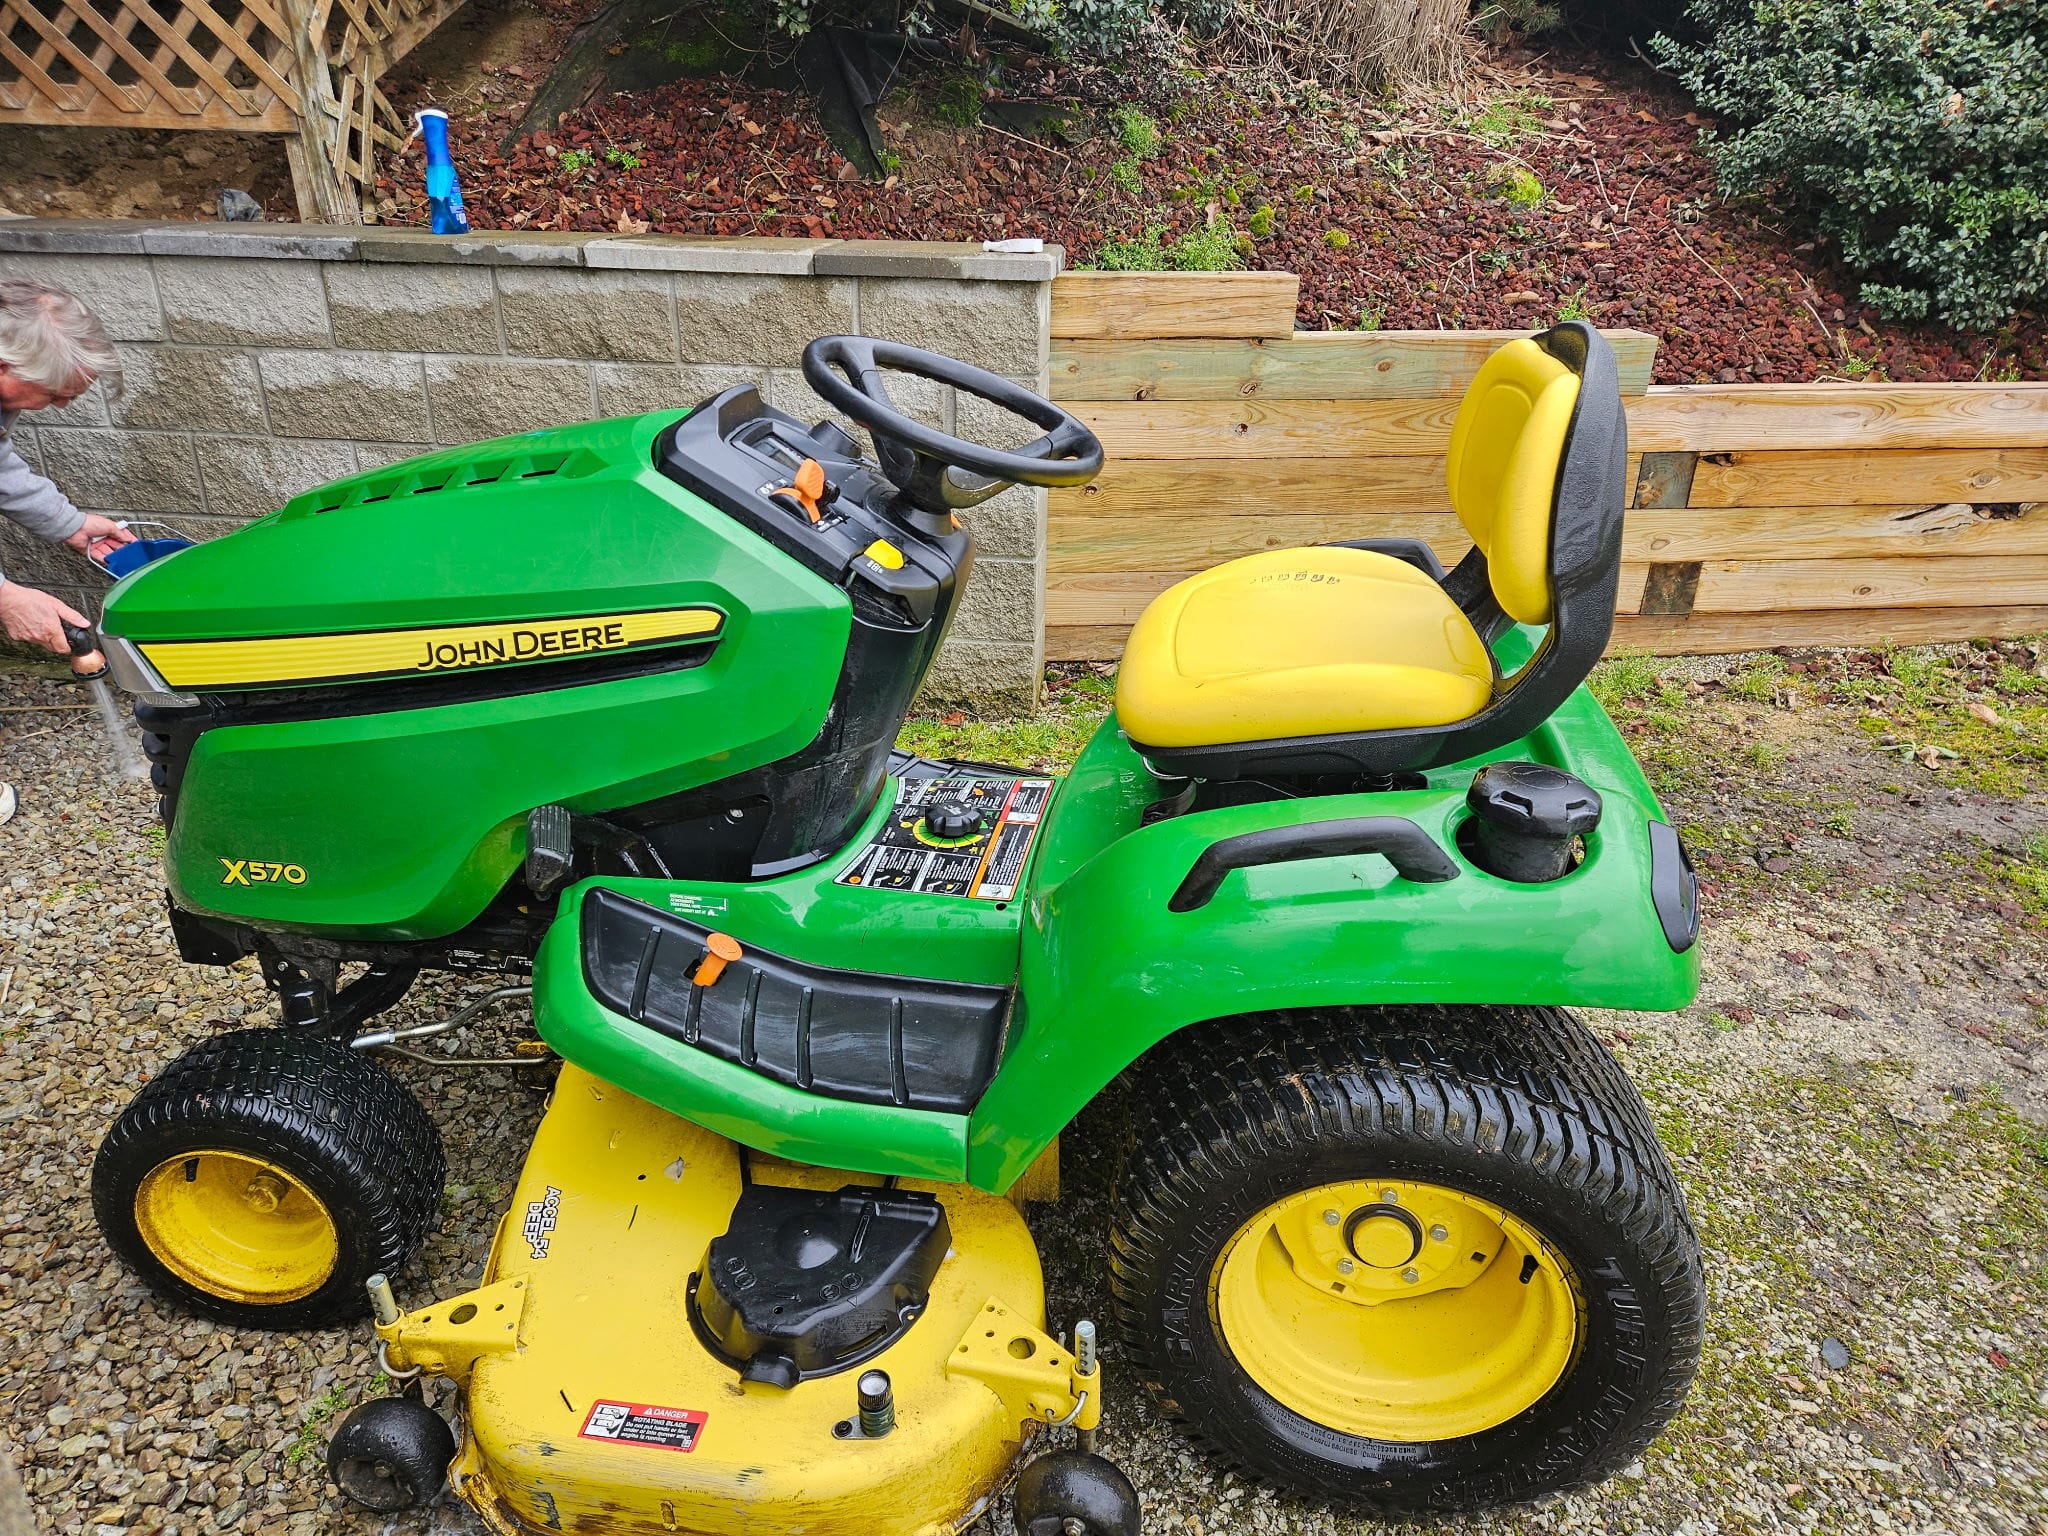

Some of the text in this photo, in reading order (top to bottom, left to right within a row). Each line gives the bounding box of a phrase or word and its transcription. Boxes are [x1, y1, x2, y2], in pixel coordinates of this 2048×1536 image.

[417, 623, 625, 668] JOHN DEERE
[218, 857, 307, 887] X570
[522, 1202, 544, 1243] DEEP
[530, 1186, 562, 1259] ACCEL 54
[632, 1416, 688, 1429] ROTATING BLADE
[653, 1408, 689, 1419] DANGER
[653, 1424, 670, 1432] hands
